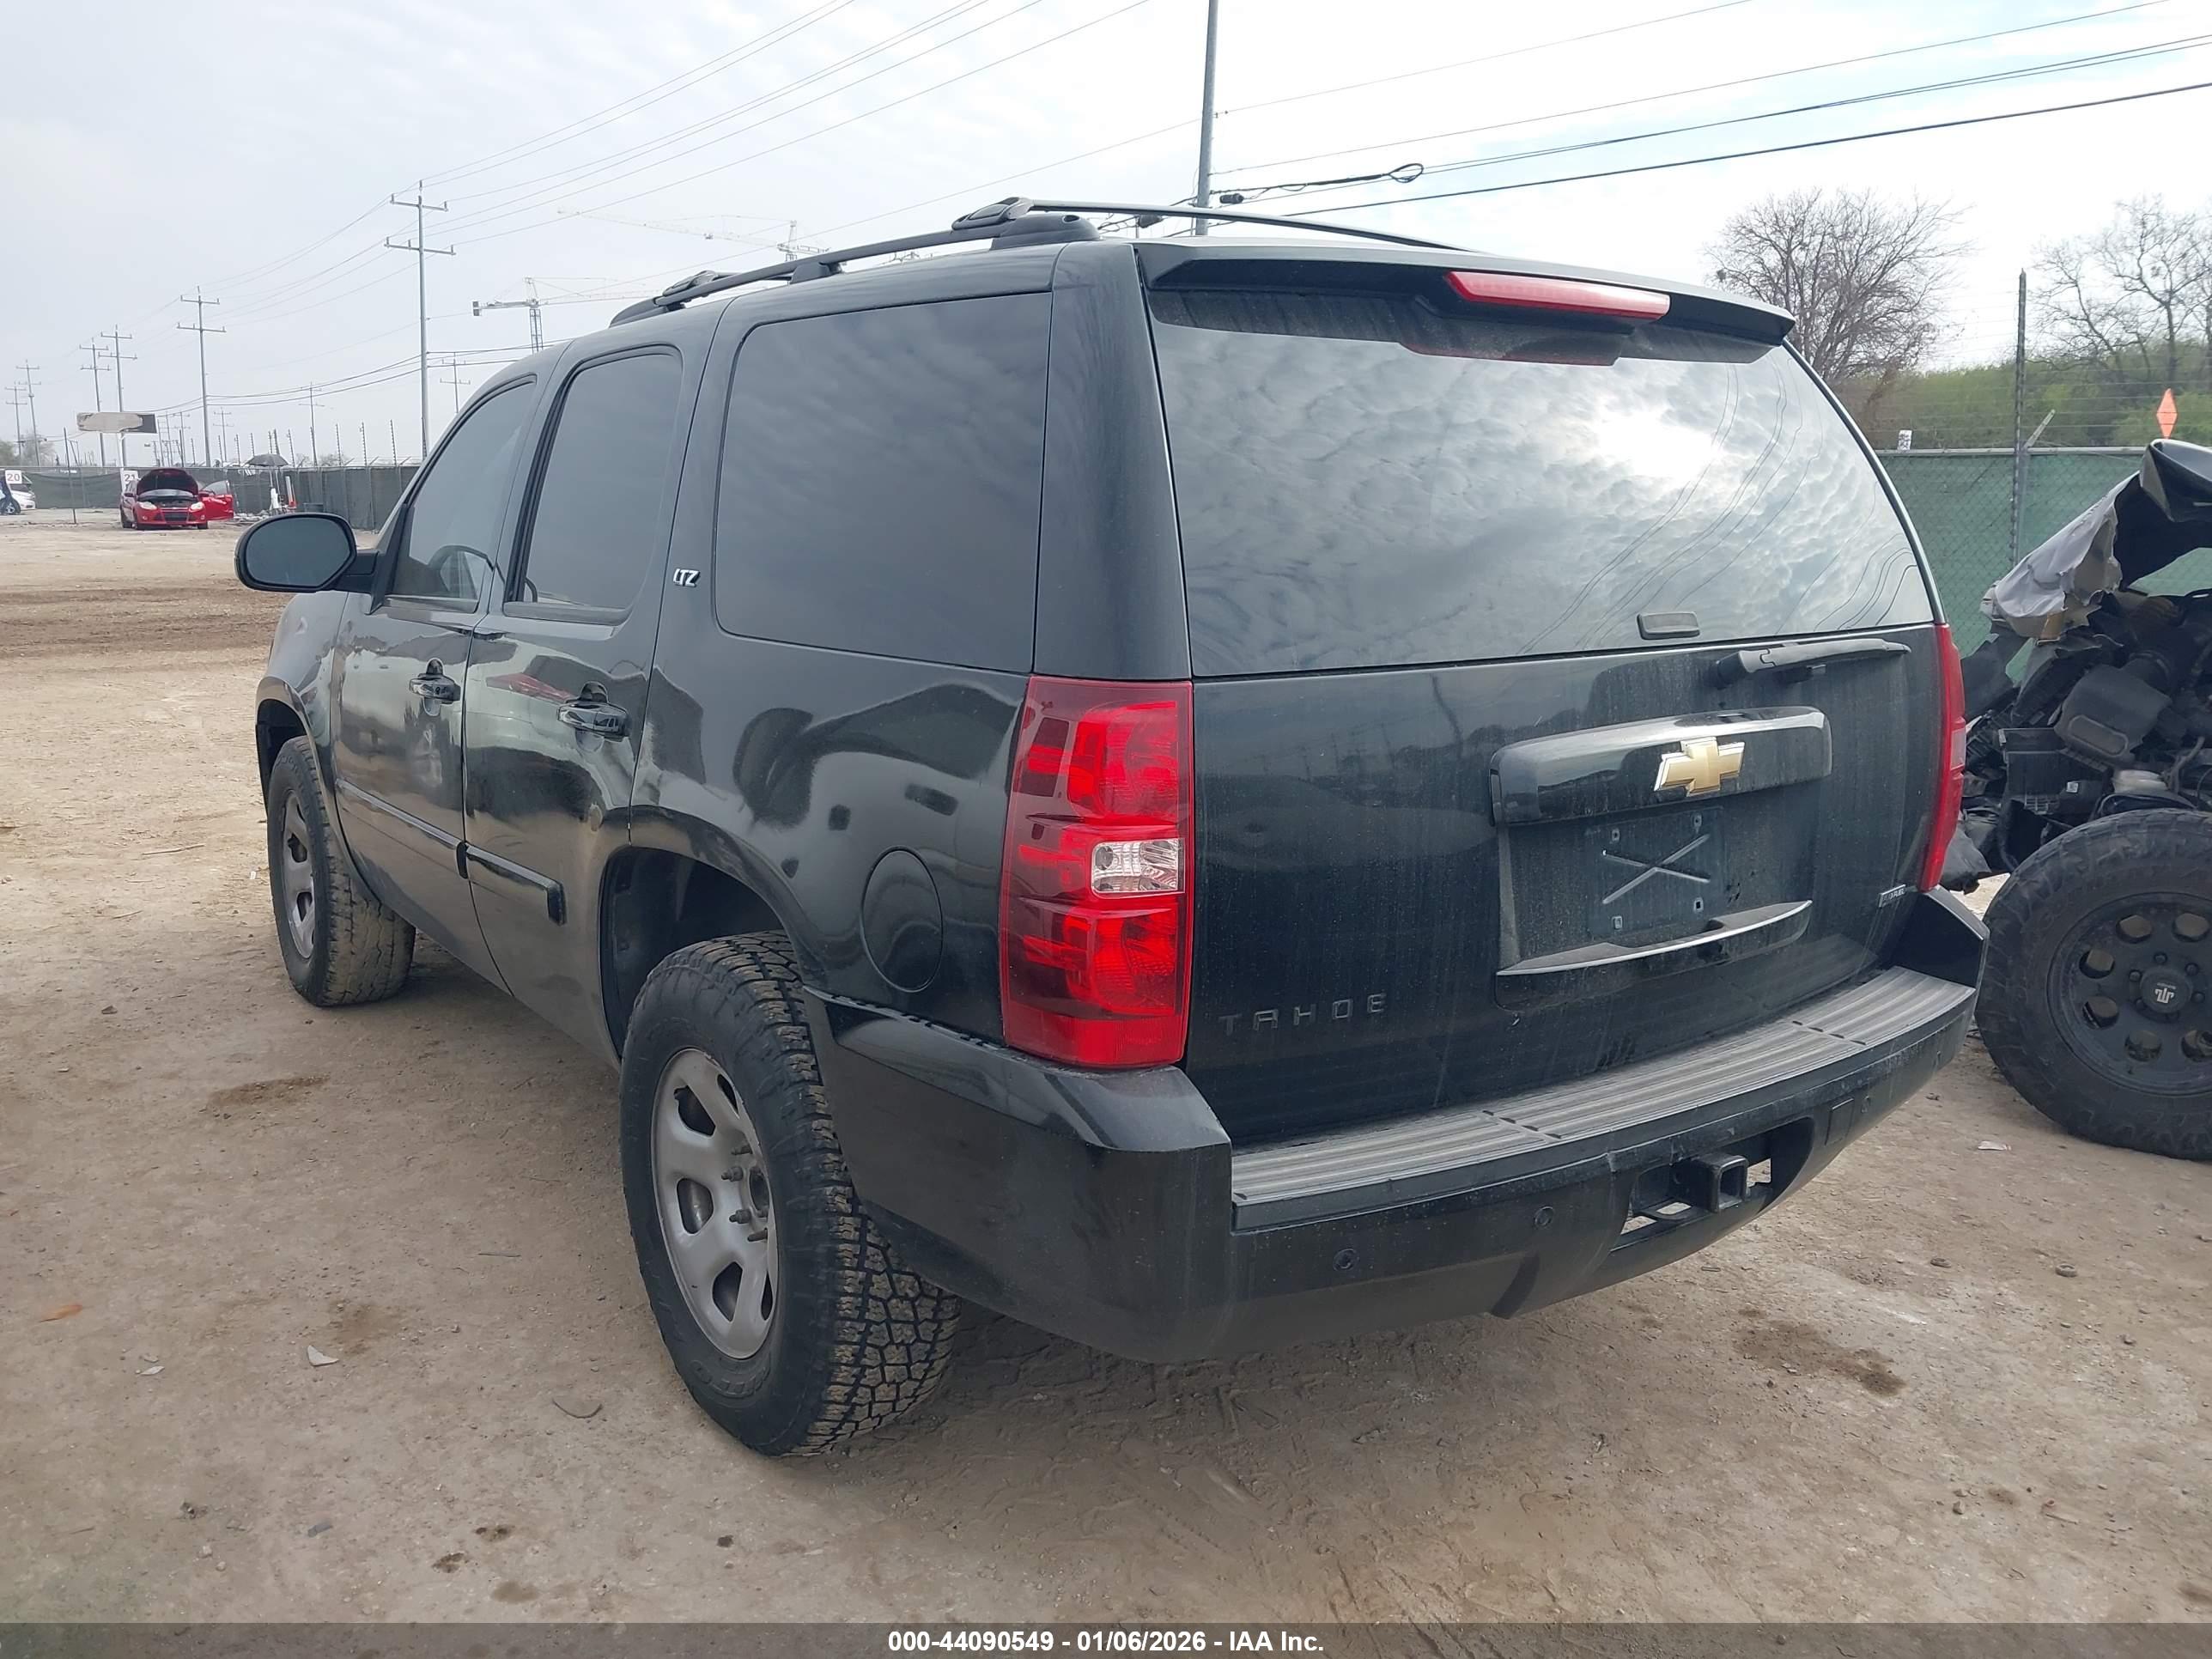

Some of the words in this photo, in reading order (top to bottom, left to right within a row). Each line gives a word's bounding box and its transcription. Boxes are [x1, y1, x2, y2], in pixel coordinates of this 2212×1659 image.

[7, 473, 21, 482] 20
[673, 568, 700, 587] LTZ
[1218, 993, 1387, 1036] TAHOE
